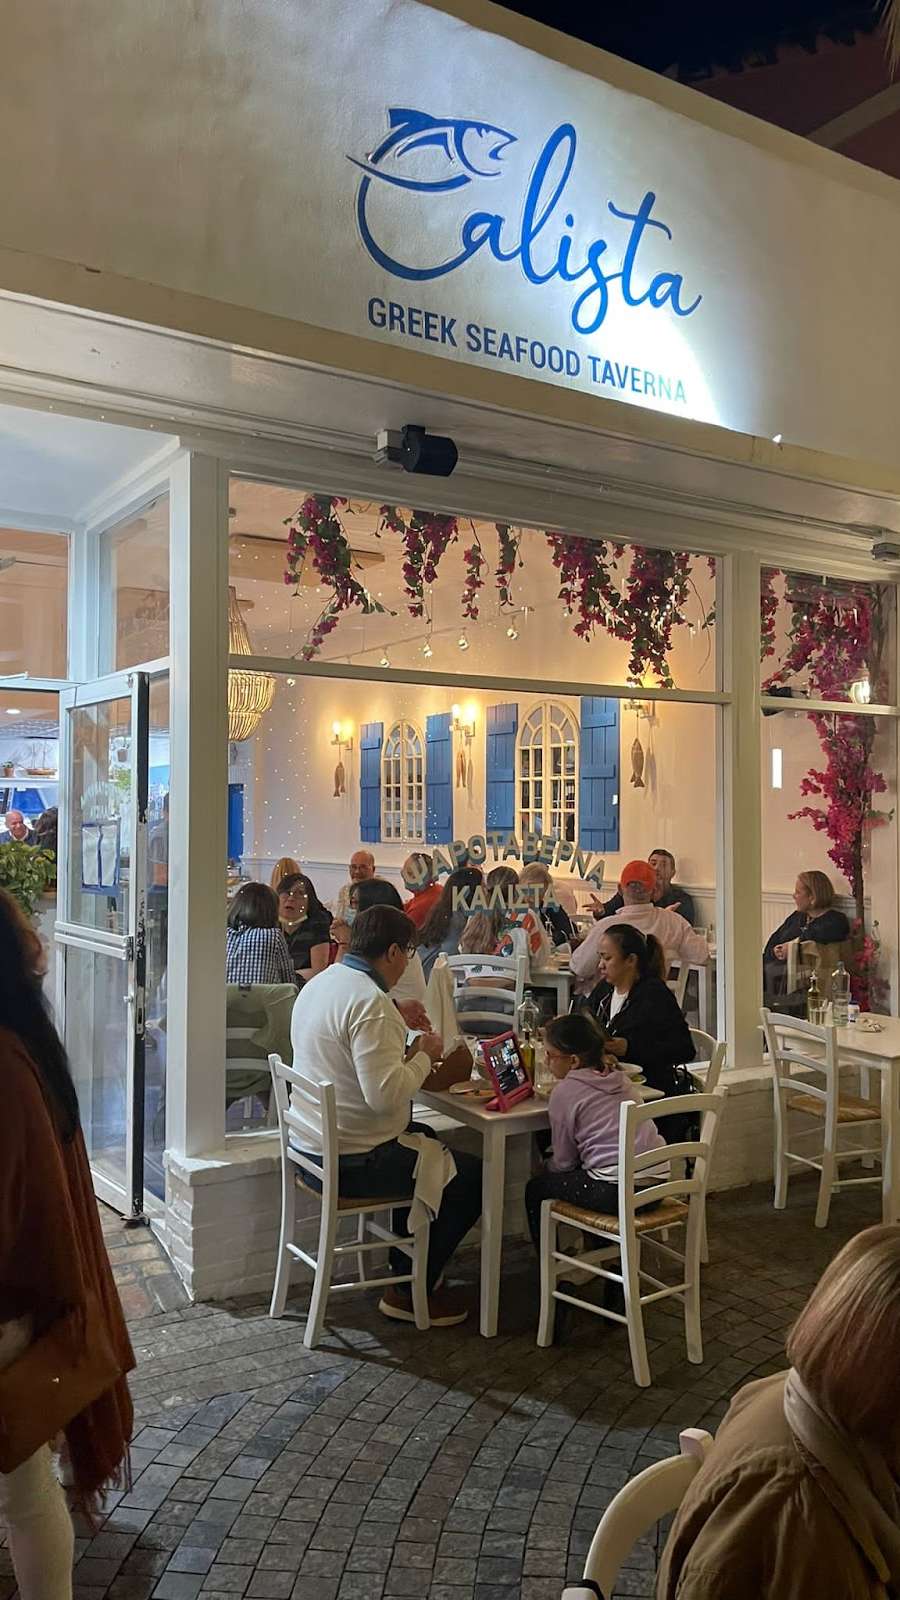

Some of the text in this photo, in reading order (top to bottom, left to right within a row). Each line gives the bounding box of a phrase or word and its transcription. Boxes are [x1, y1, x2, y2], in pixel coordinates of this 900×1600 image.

[347, 108, 702, 334] Calista
[368, 298, 686, 403] GREEK SEAFOOD TAVERNA
[452, 884, 559, 911] ΚΑΛΙΣΤΑ
